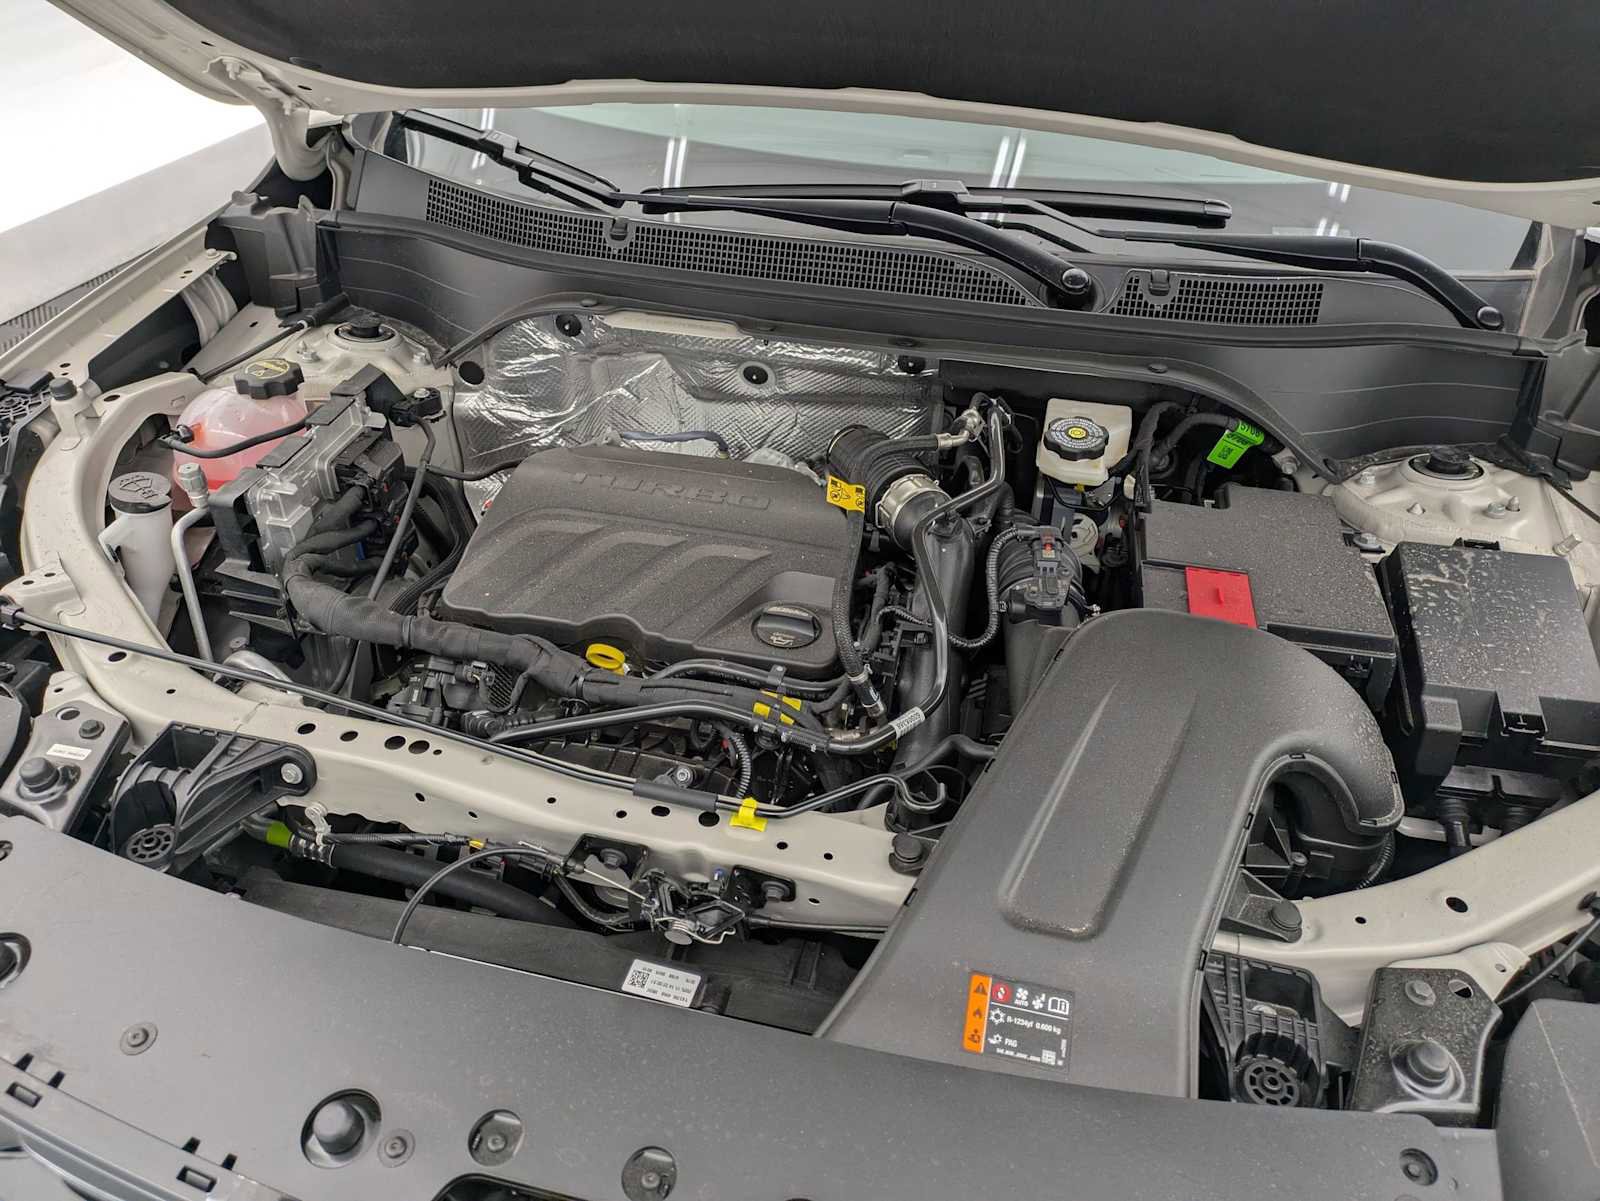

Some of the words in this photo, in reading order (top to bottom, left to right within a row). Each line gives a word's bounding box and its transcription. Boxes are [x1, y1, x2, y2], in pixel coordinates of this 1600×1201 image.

[572, 472, 771, 511] TURBO
[1006, 1015, 1034, 1029] R-1234yf
[1052, 1025, 1062, 1036] kg
